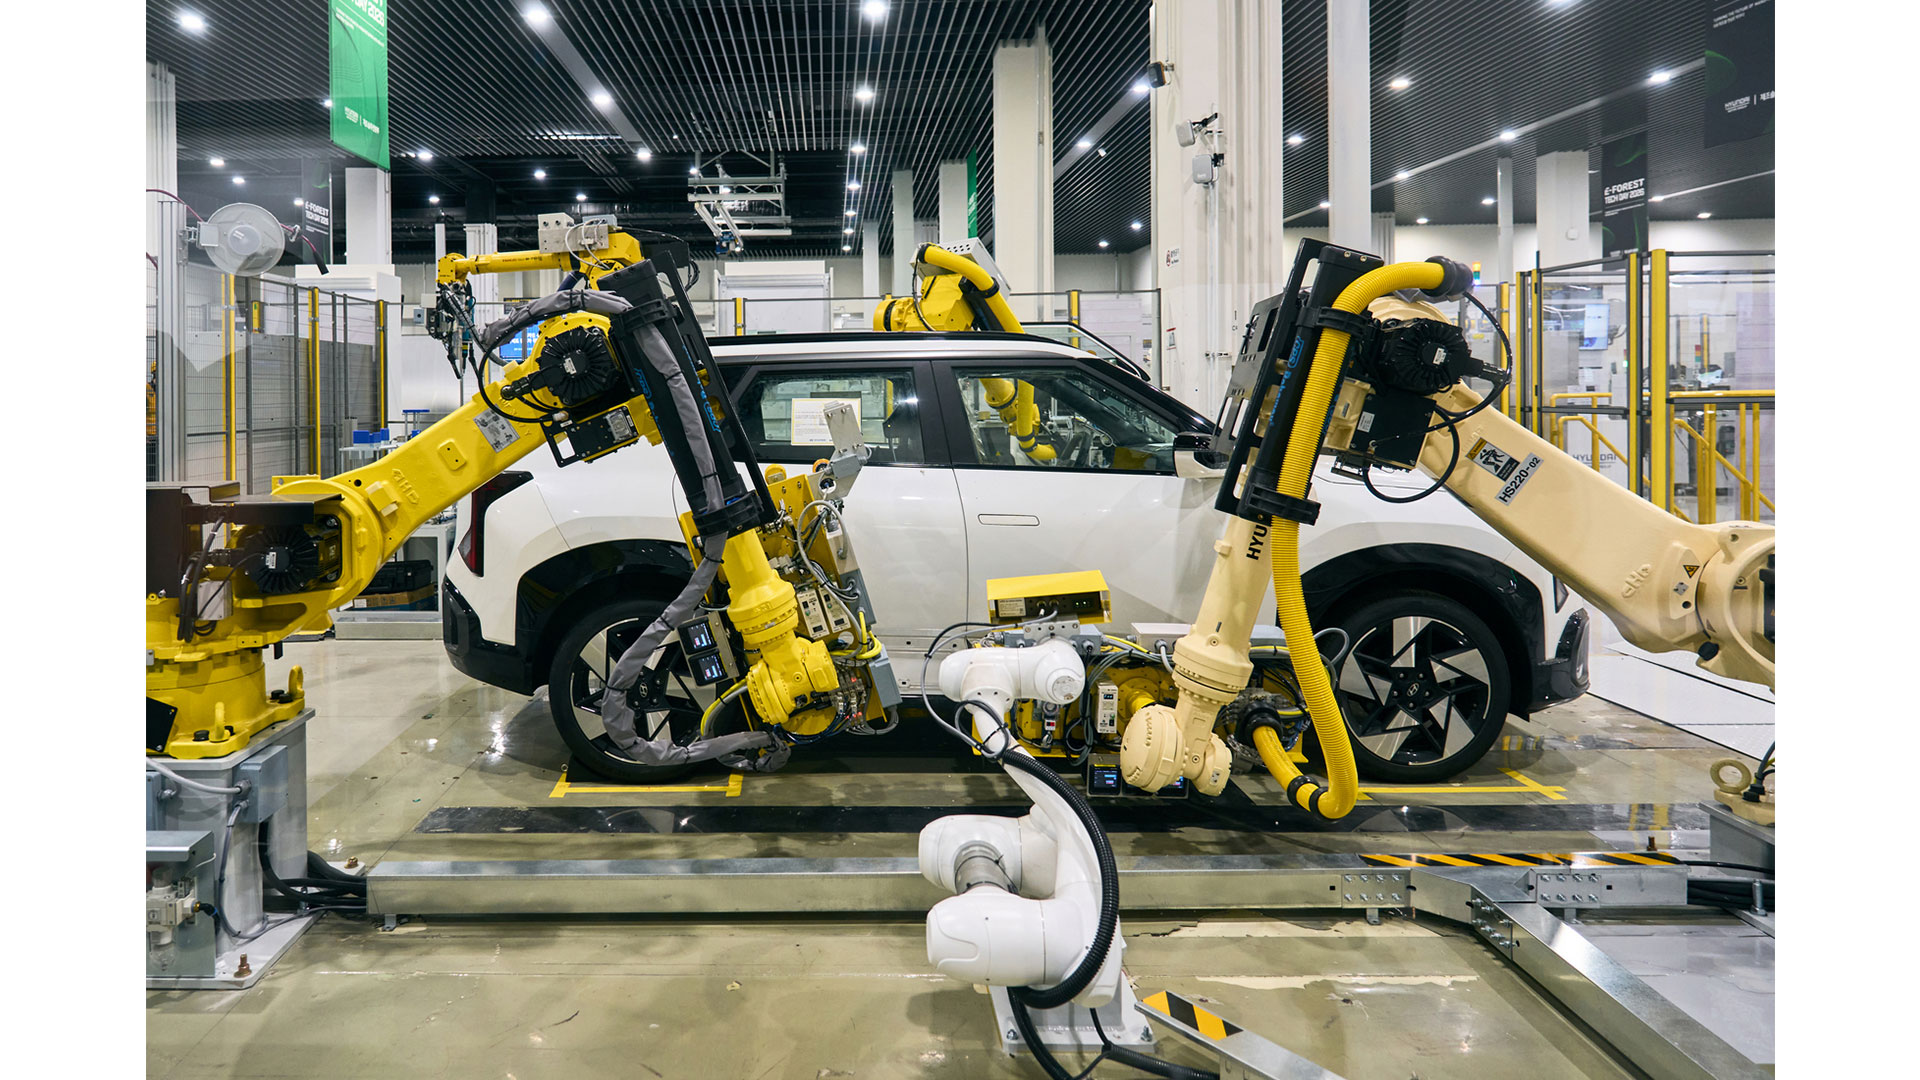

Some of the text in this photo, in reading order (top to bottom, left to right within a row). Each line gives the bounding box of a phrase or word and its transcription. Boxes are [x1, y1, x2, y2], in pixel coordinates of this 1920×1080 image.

[1604, 178, 1645, 196] E-FOREST
[1605, 194, 1619, 205] TECH
[1572, 453, 1617, 462] HYUDAI
[1499, 457, 1541, 503] HS220-02
